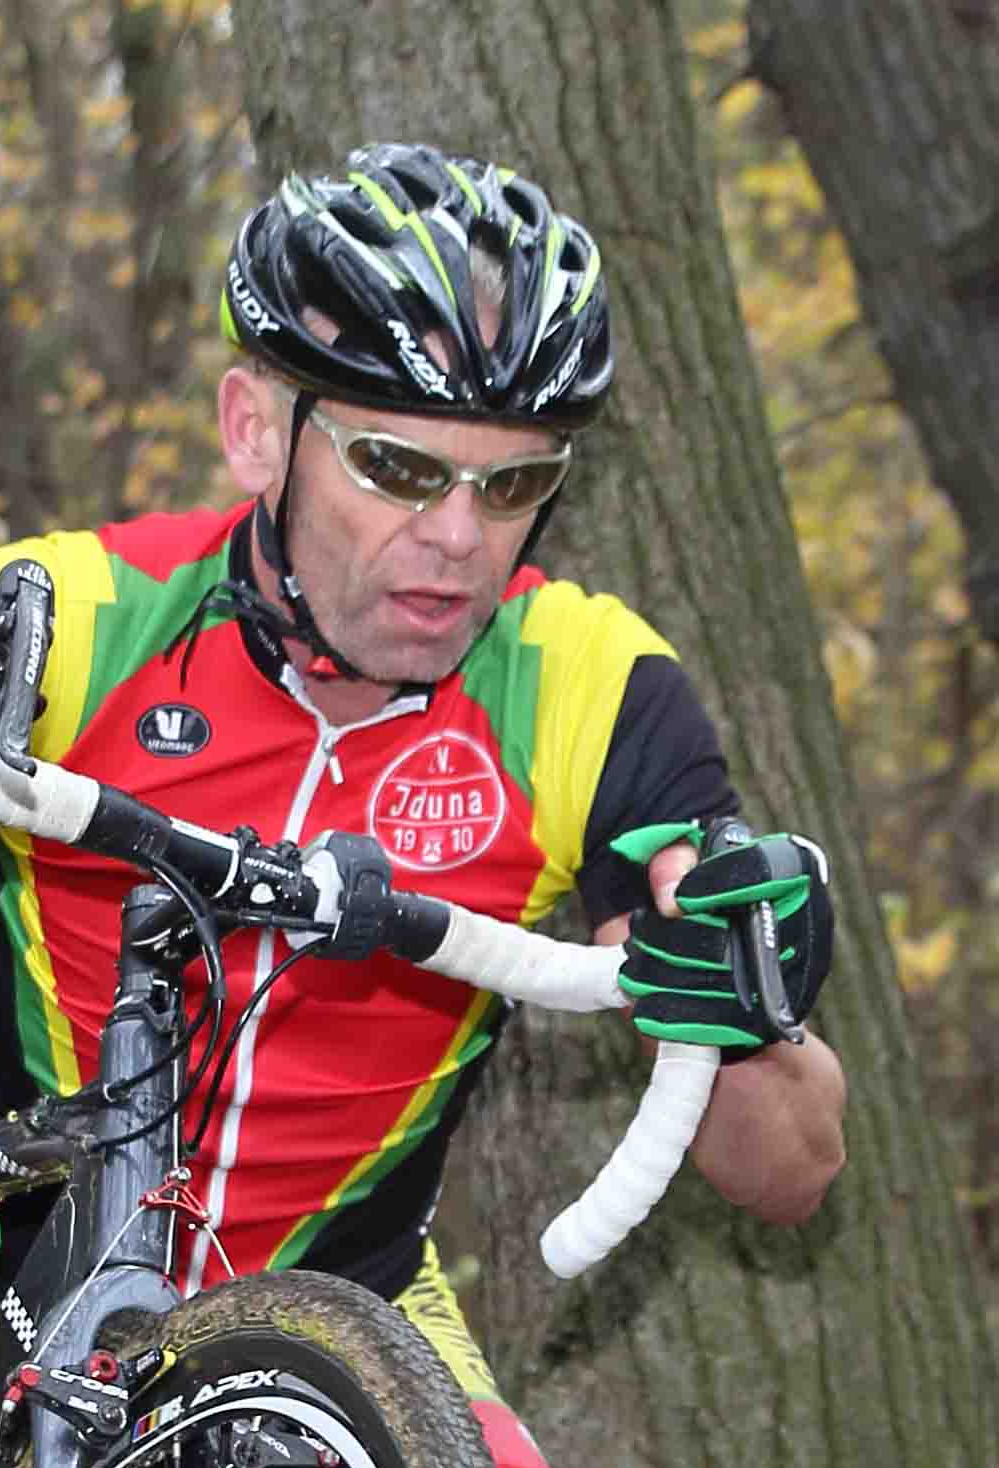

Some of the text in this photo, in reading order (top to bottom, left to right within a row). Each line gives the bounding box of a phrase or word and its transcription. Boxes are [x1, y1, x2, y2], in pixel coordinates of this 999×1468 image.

[387, 319, 454, 400] RUDY
[532, 338, 585, 413] RUDY
[393, 826, 475, 853] 19 10
[188, 1368, 280, 1409] APEX
